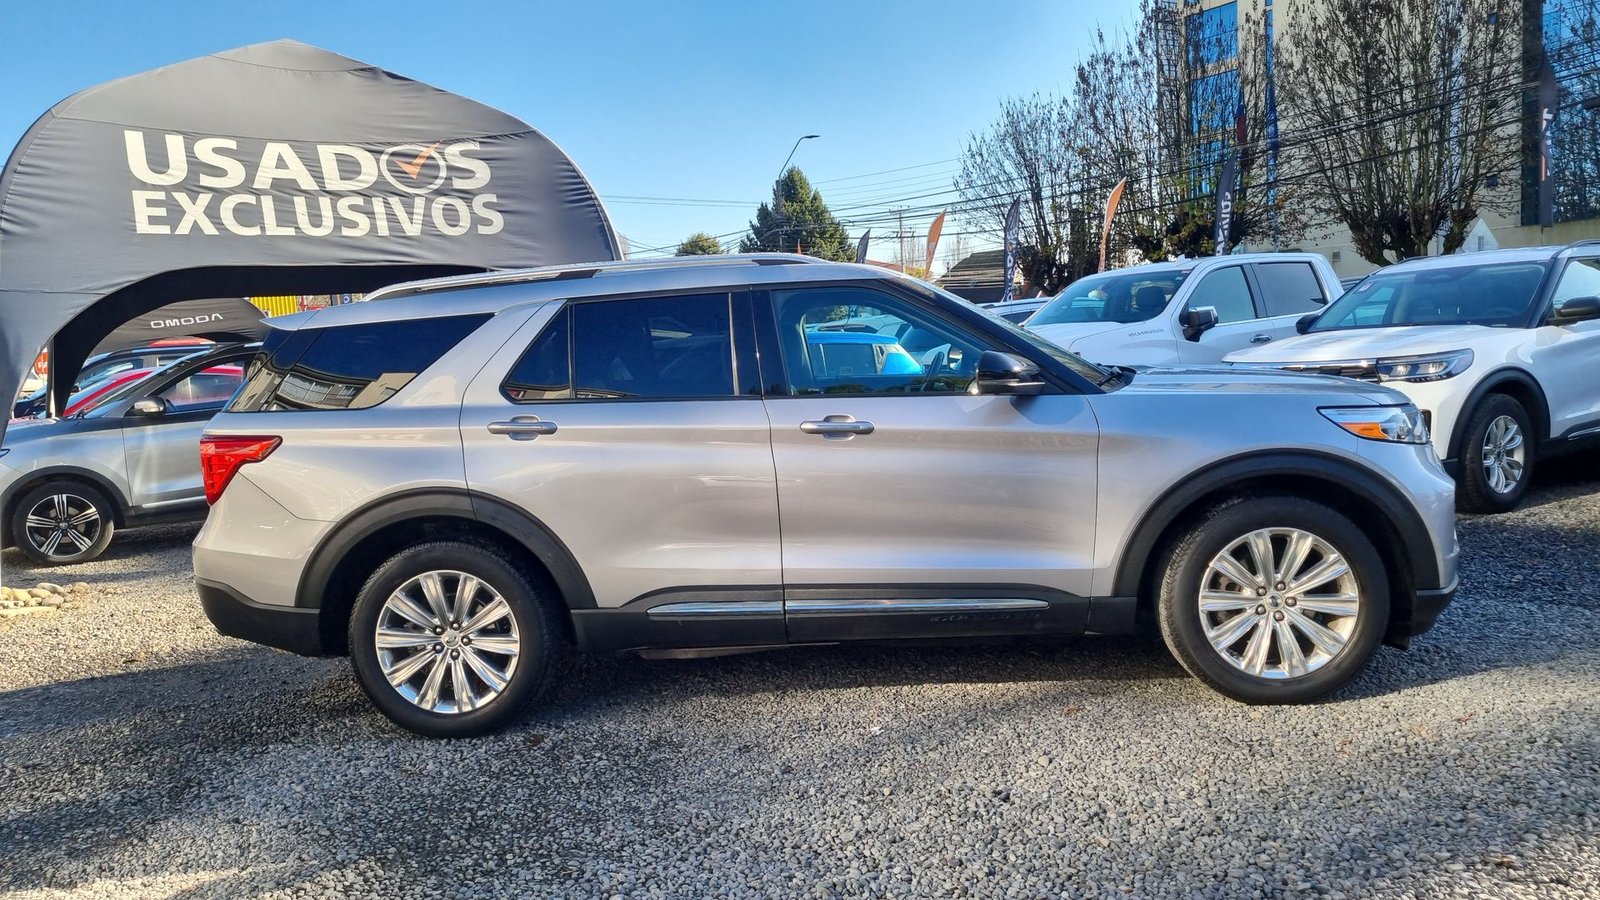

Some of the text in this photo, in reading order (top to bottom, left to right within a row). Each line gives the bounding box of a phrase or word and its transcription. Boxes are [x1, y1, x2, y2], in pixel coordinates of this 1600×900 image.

[123, 129, 492, 194] USADOS
[131, 190, 505, 236] EXCLUSIVOS
[150, 313, 224, 329] OMODA
